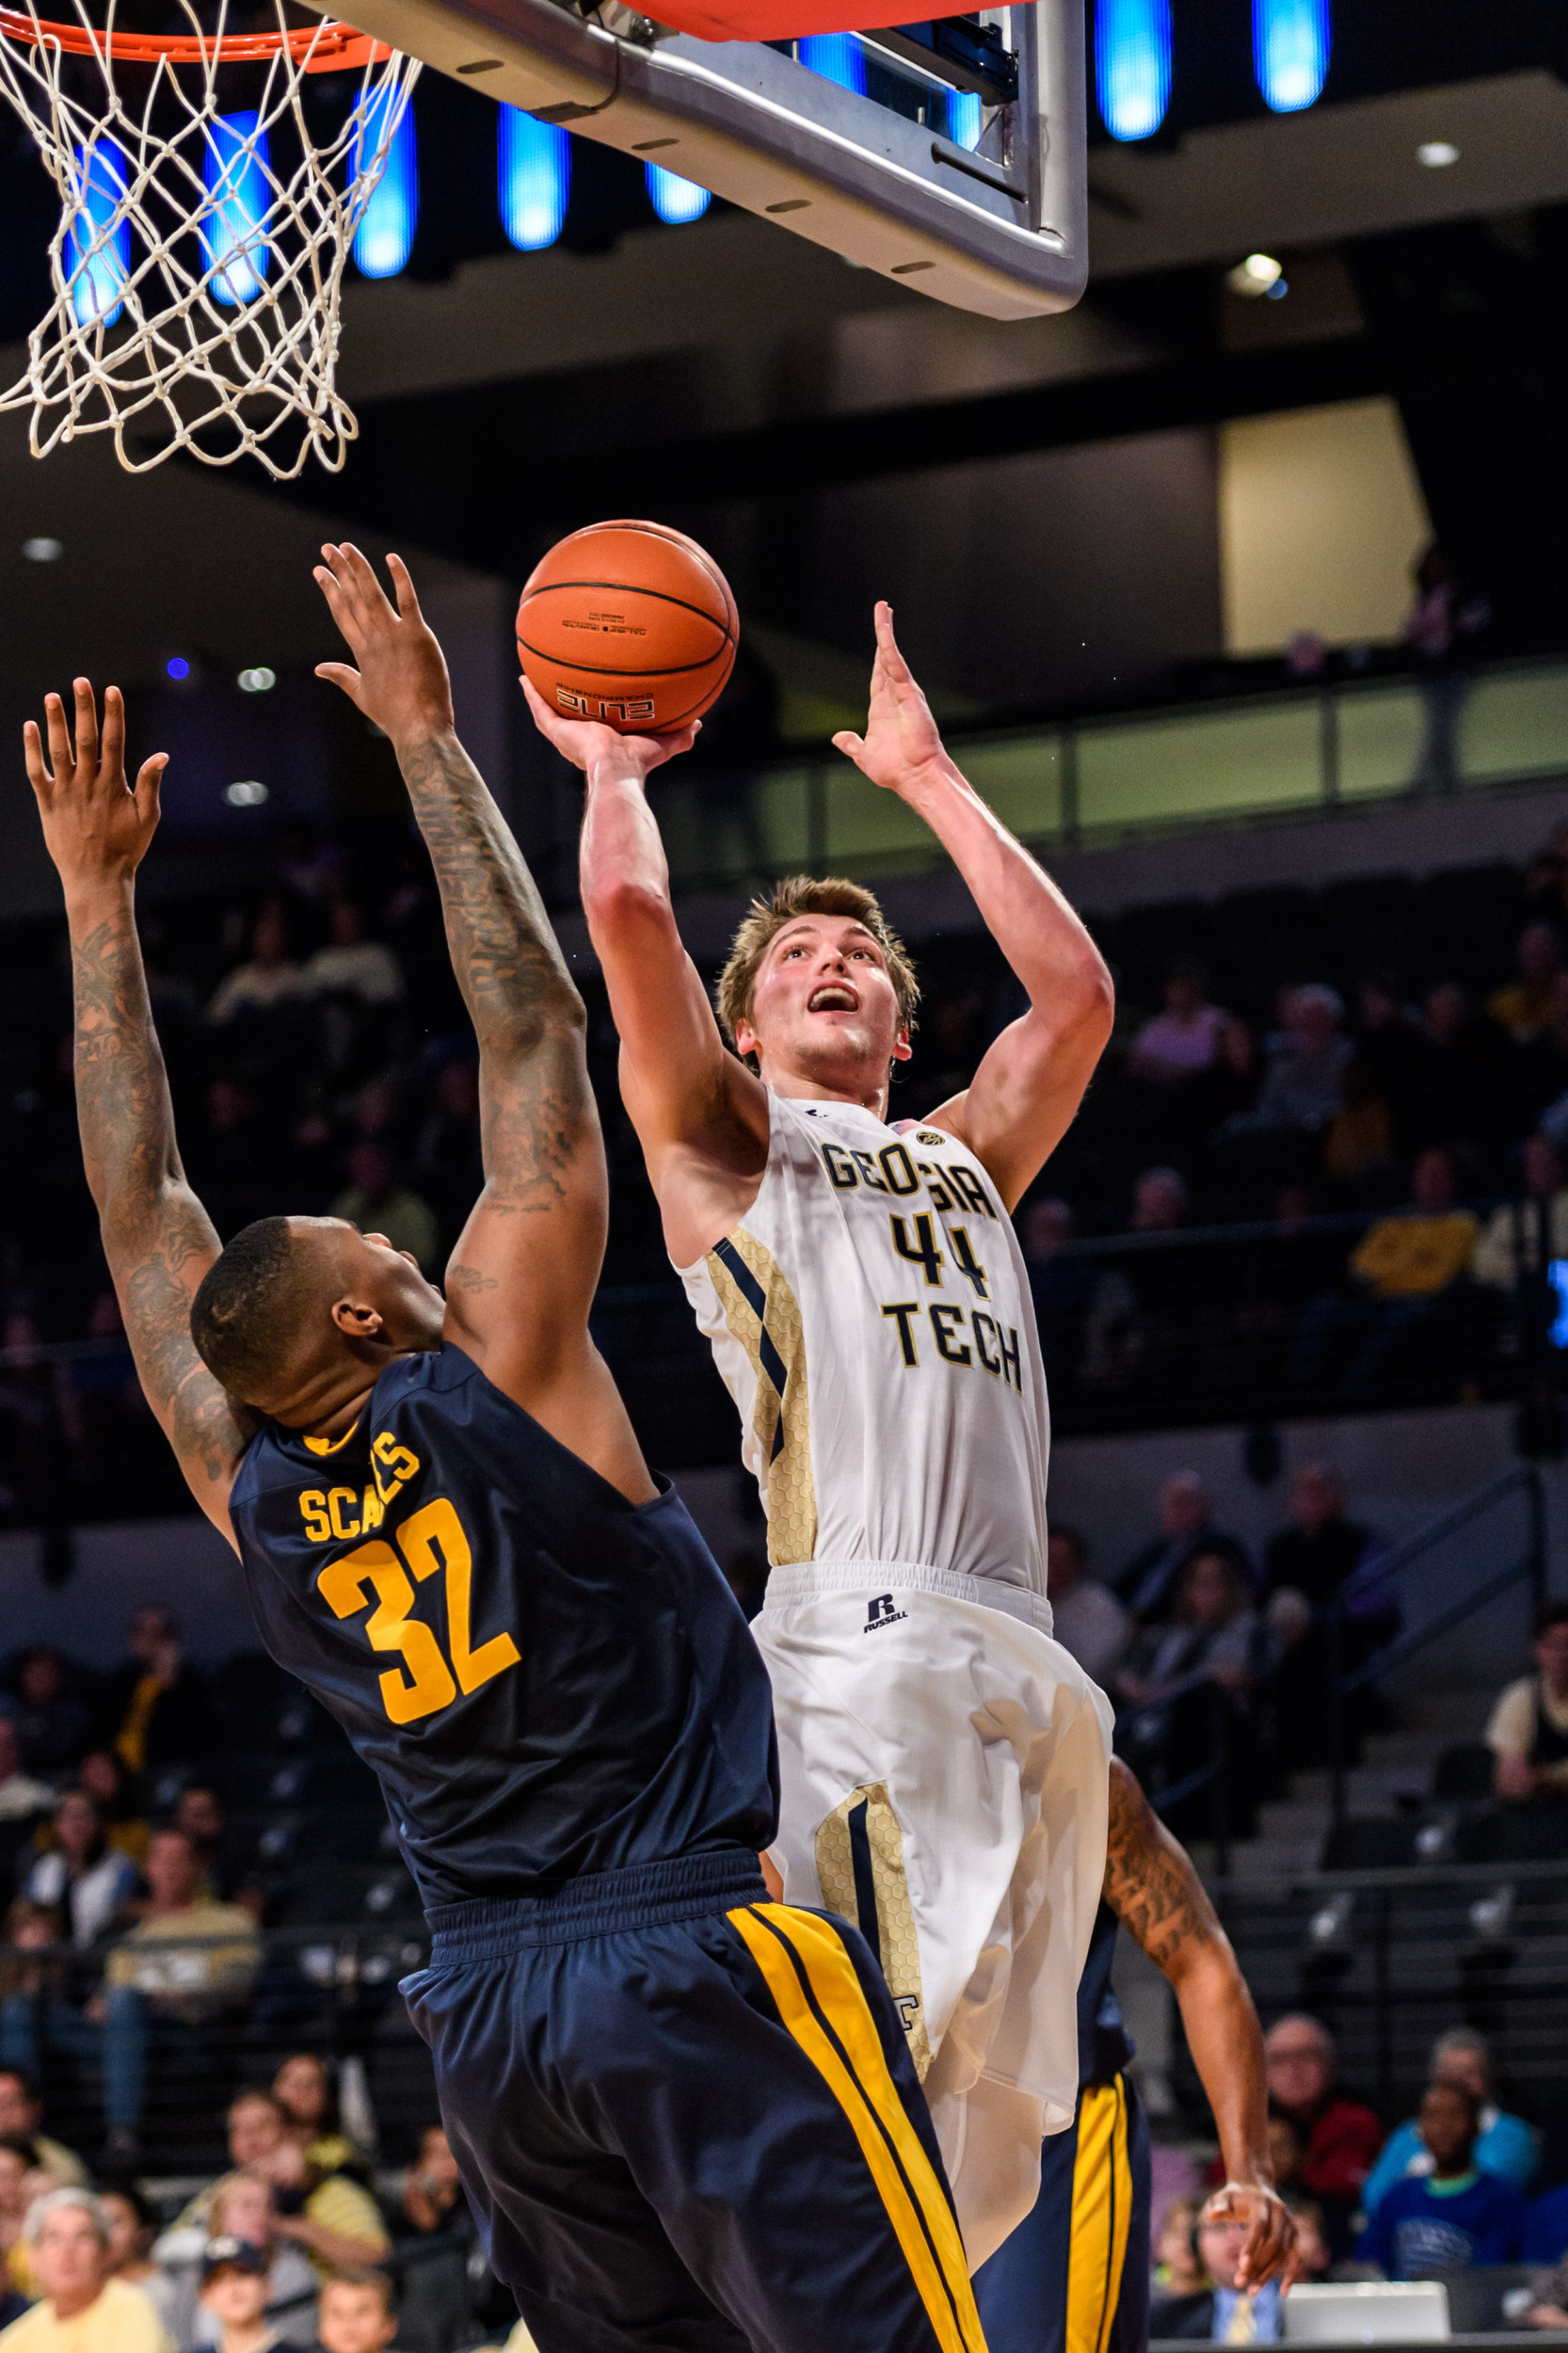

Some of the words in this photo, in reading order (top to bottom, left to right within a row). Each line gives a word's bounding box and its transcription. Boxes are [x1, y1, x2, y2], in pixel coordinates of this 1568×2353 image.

[557, 688, 655, 722] ELITE
[822, 1142, 1000, 1223] GEOGIA
[889, 1211, 992, 1302] 44
[881, 1302, 1024, 1395] TECH
[299, 1432, 420, 1542] SCAS
[317, 1497, 522, 1724] 32
[863, 1610, 908, 1634] RUSSELL
